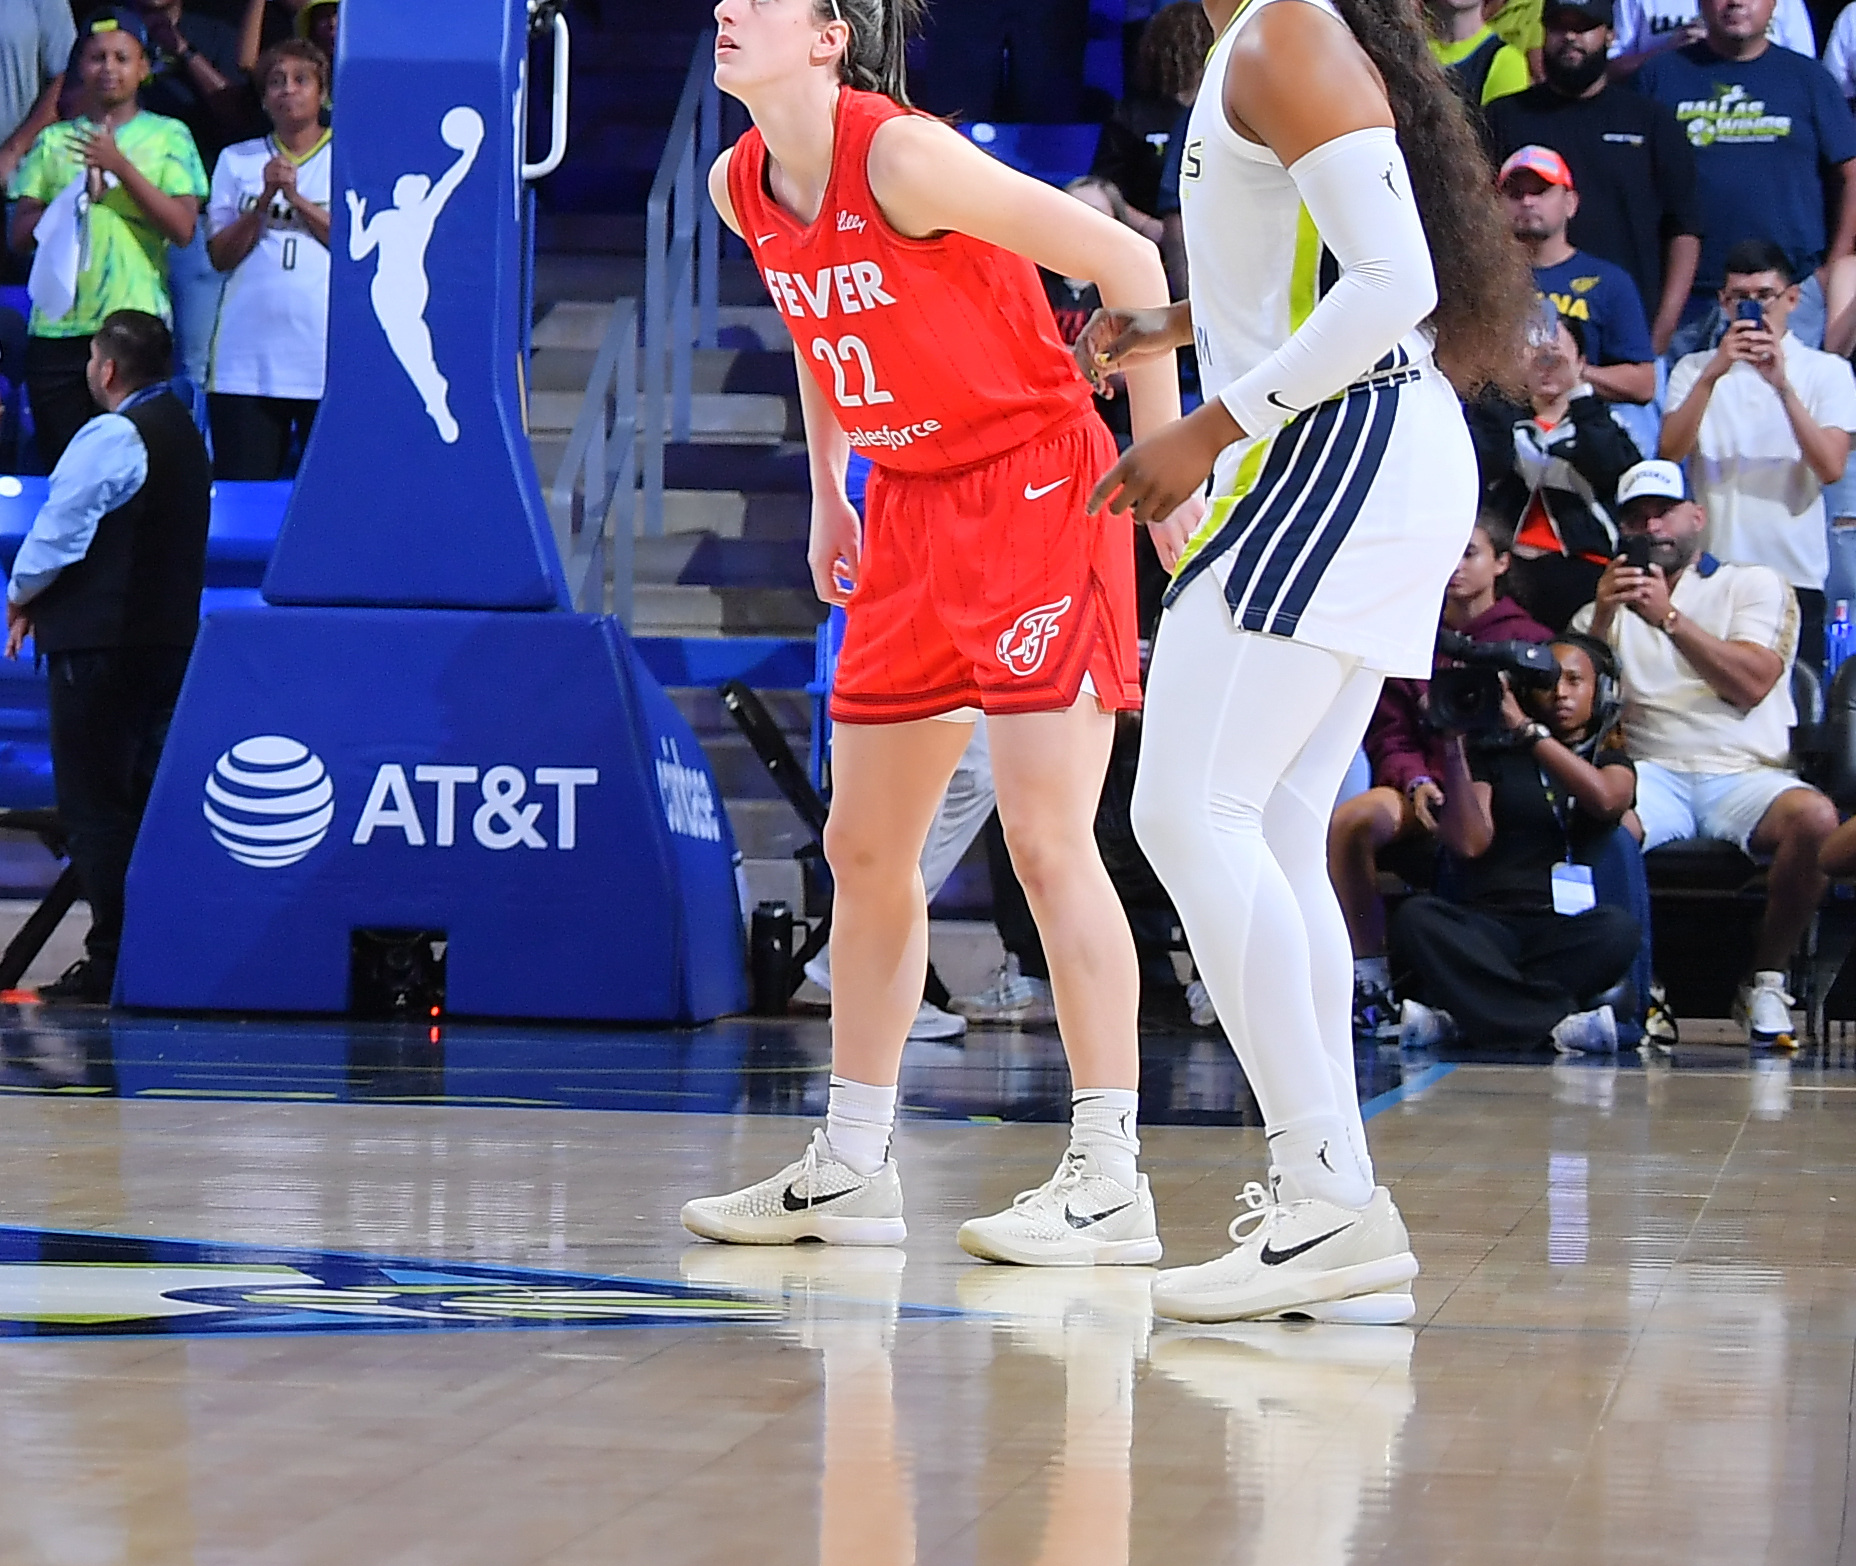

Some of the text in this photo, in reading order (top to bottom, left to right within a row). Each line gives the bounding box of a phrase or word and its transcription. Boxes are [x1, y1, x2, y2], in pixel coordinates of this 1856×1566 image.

[762, 260, 898, 320] FEVER
[811, 334, 894, 408] 22
[843, 416, 944, 452] salesforce
[352, 763, 600, 851] AT&T
